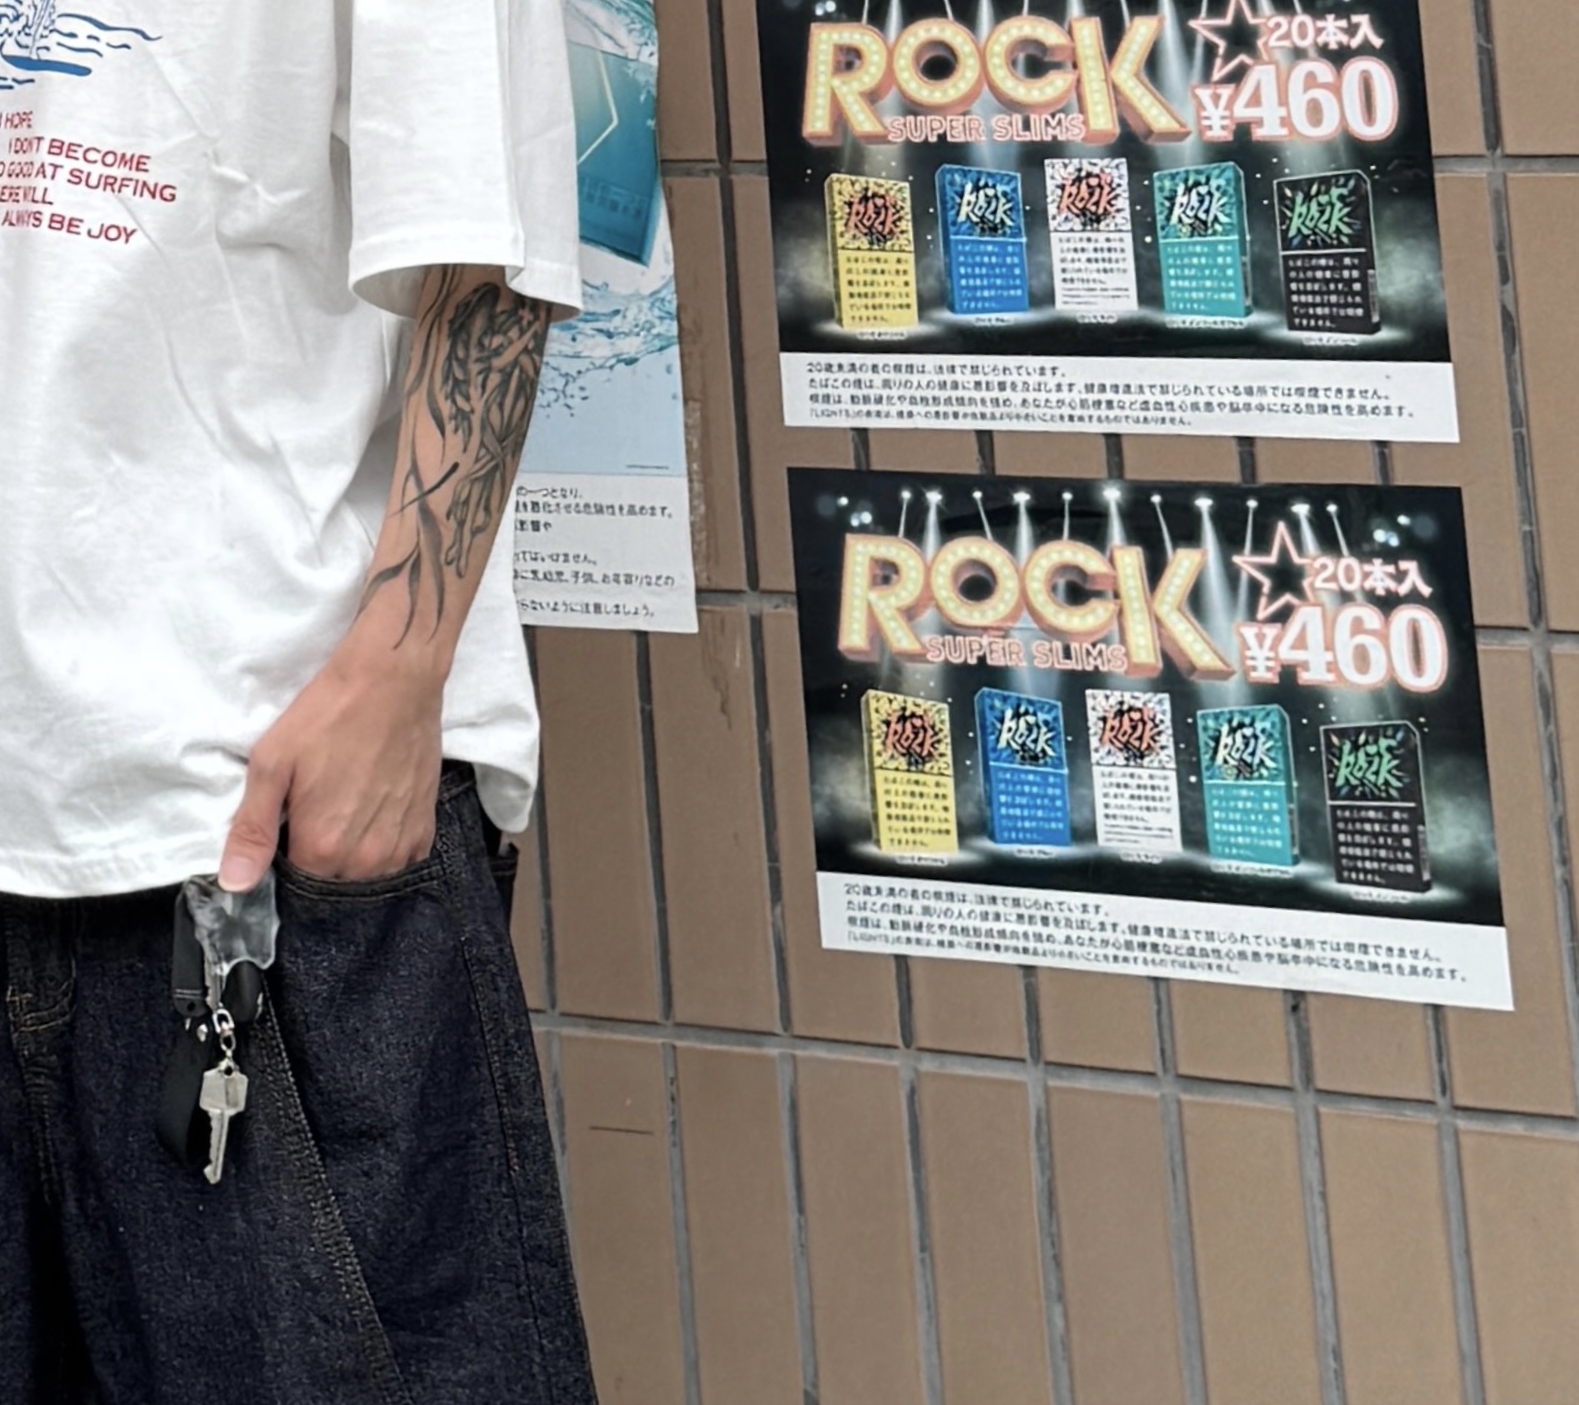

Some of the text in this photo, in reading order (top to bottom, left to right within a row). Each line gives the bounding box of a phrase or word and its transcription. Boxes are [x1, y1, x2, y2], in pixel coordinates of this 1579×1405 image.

[1265, 11, 1385, 51] 20本入
[803, 14, 1191, 145] ROCK
[1193, 57, 1400, 140] ¥460
[4, 110, 33, 129] HOPE
[886, 113, 1087, 142] SUPER SLIMS
[47, 138, 152, 173] BECOME
[35, 162, 64, 181] AT
[67, 167, 178, 203] SURFING
[48, 213, 84, 236] BE
[87, 223, 138, 245] JOY
[1309, 555, 1433, 598] 20本入
[839, 532, 1235, 678] ROCK
[924, 634, 1129, 672] SUPER SLIMS
[1237, 603, 1448, 690] ¥460
